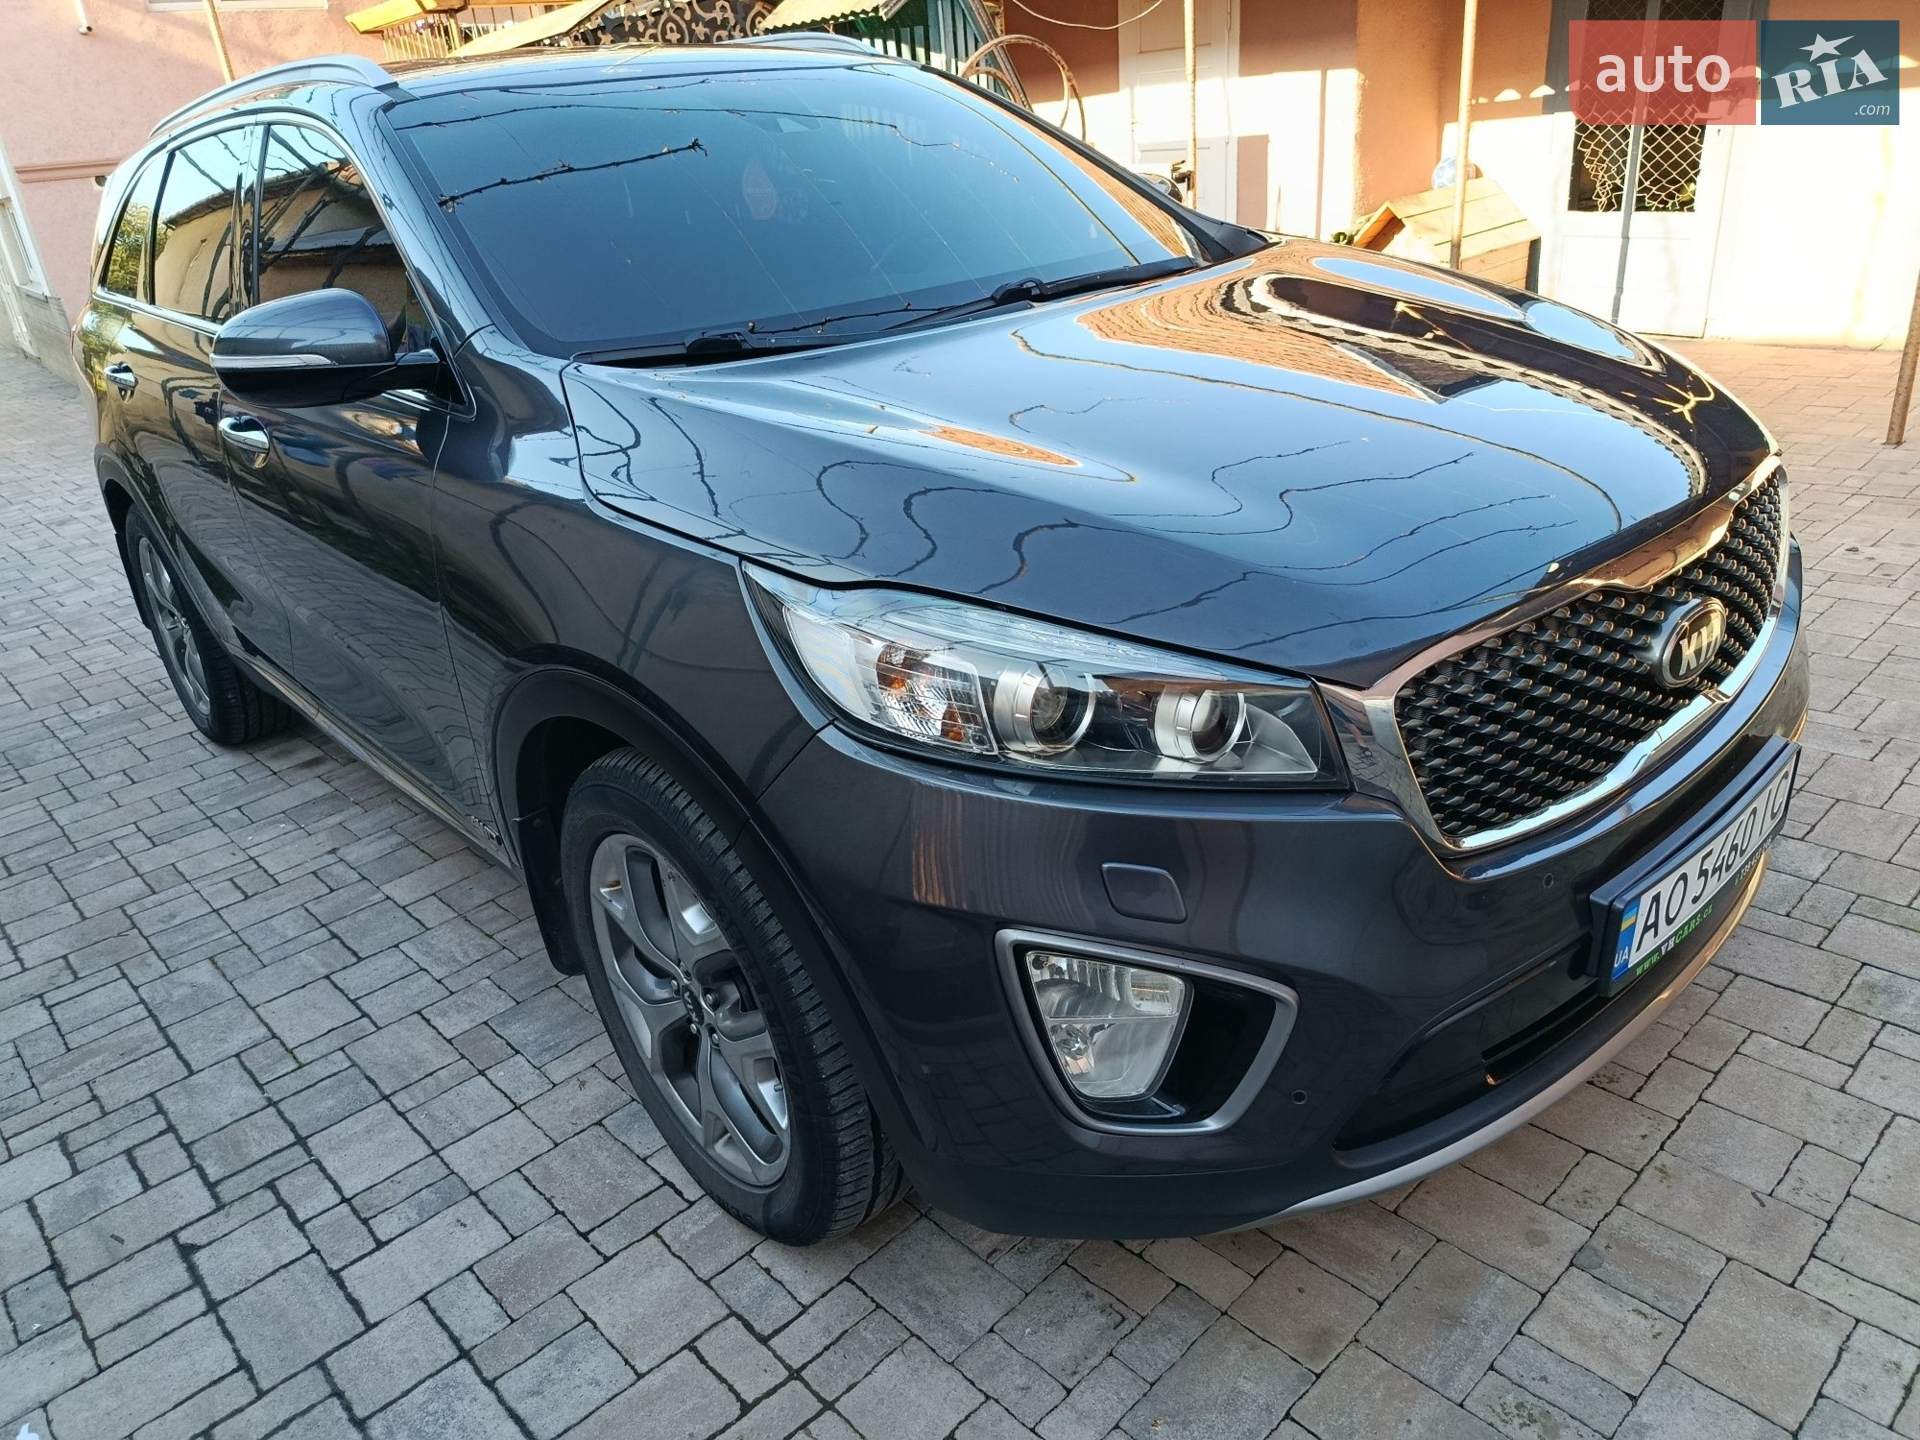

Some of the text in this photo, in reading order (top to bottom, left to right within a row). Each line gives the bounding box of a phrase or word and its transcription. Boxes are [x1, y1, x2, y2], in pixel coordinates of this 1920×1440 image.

[1635, 871, 1689, 954] AO
[1691, 804, 1758, 905] 5460
[1759, 768, 1789, 837] IC
[1614, 945, 1629, 969] UA
